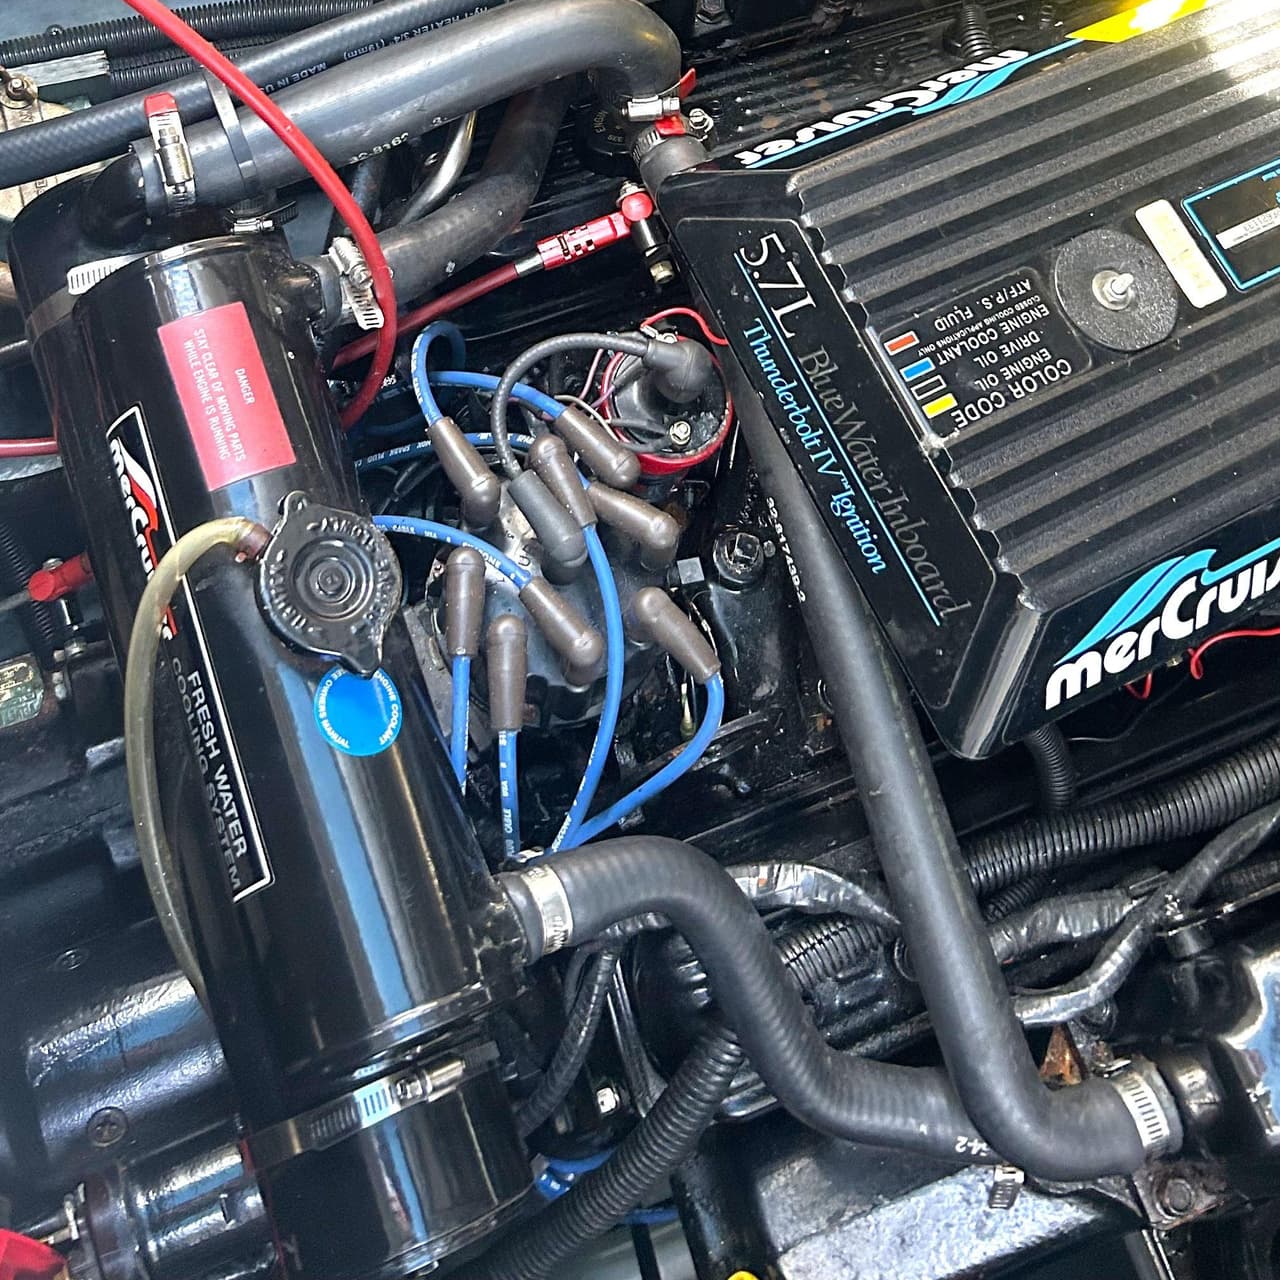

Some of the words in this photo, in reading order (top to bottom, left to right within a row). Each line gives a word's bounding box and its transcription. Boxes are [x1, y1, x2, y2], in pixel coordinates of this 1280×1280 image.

[276, 76, 289, 87] IN
[290, 61, 327, 82] MADE
[733, 49, 1030, 166] merCruiser
[739, 232, 817, 339] 5.7L
[984, 307, 1015, 325] COOLING
[1016, 295, 1041, 311] CLOSED
[934, 307, 974, 331] FLUID
[936, 322, 983, 347] APPLICATIONS
[999, 303, 1050, 335] ENGINE
[193, 328, 210, 350] STAY
[917, 345, 935, 357] ONLY
[937, 328, 998, 366] COOLANT
[999, 330, 1040, 357] DRIVE
[183, 340, 201, 371] WHILE
[201, 351, 219, 379] CLEAR
[973, 350, 998, 368] OIL
[1000, 348, 1052, 381] ENGINE
[193, 370, 213, 404] ENGINE
[212, 381, 225, 393] OF
[234, 368, 255, 405] DANGER
[974, 373, 999, 391] OIL
[1008, 359, 1072, 400] COLOR
[205, 404, 216, 416] IS
[215, 394, 236, 432] MOVING
[950, 391, 1006, 429] CODE
[208, 416, 231, 461] RUNNING
[227, 432, 247, 463] PARTS
[742, 317, 822, 459] Thunderbolt
[830, 487, 888, 575] Ignition
[877, 494, 972, 618] Inboard
[322, 719, 350, 748] MANUAL
[379, 703, 398, 745] COOLANT
[172, 657, 208, 775] COOLING
[206, 782, 242, 889] SYSTEM
[187, 671, 220, 760] FRESH
[214, 764, 248, 859] WATER
[503, 807, 513, 833] CABLE
